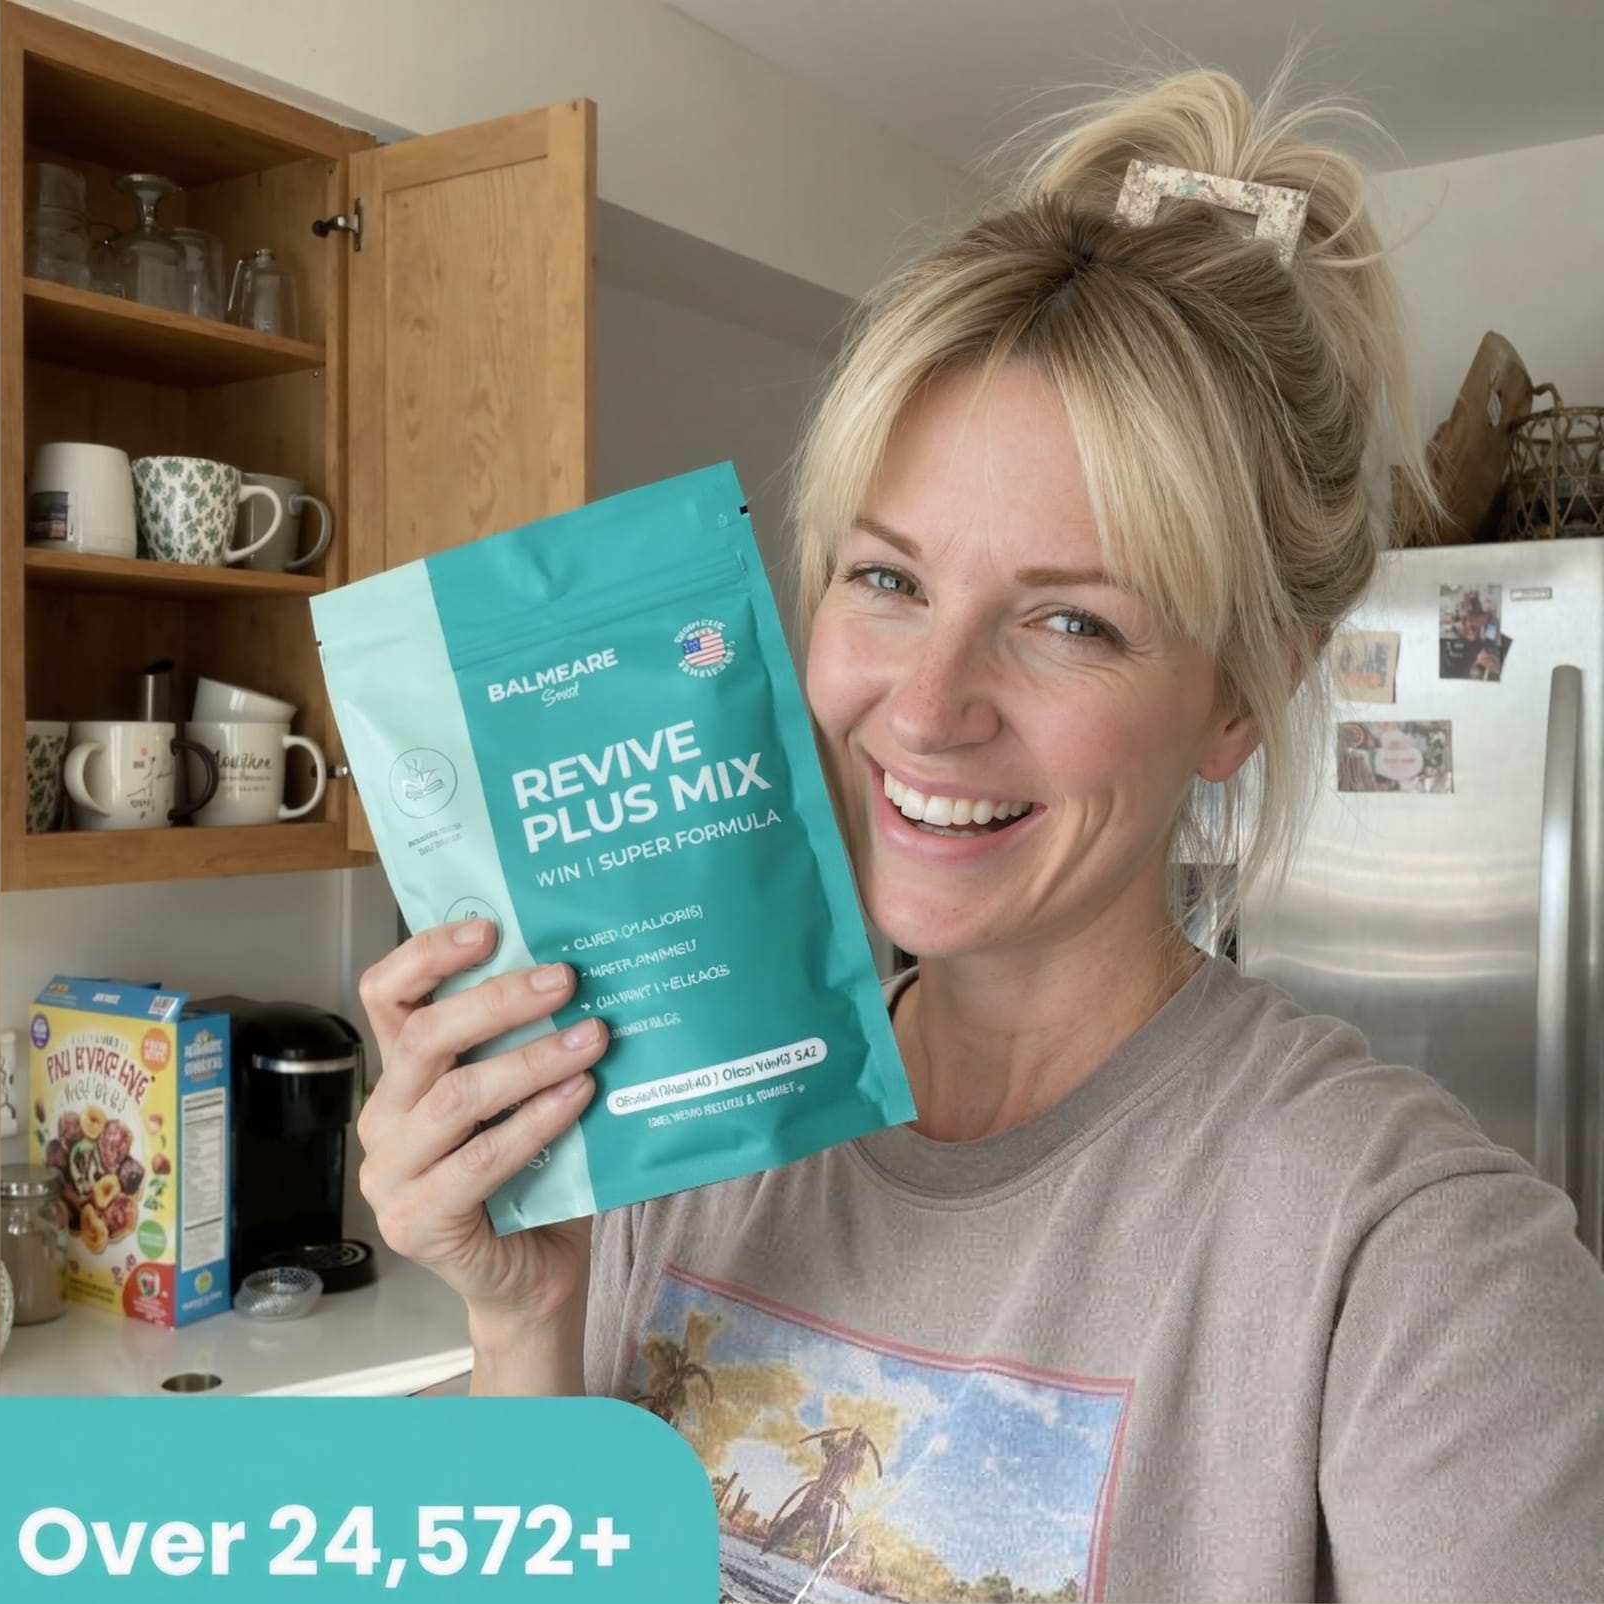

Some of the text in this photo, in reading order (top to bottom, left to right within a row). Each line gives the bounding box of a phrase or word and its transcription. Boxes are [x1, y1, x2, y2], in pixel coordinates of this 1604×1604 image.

[487, 647, 619, 703] BALMEARE
[512, 719, 702, 810] REVIVE
[522, 782, 659, 854] PLUS
[668, 752, 773, 812] MIX
[536, 862, 581, 888] WIN
[598, 836, 672, 871] SUPER
[675, 808, 782, 850] FORMULA
